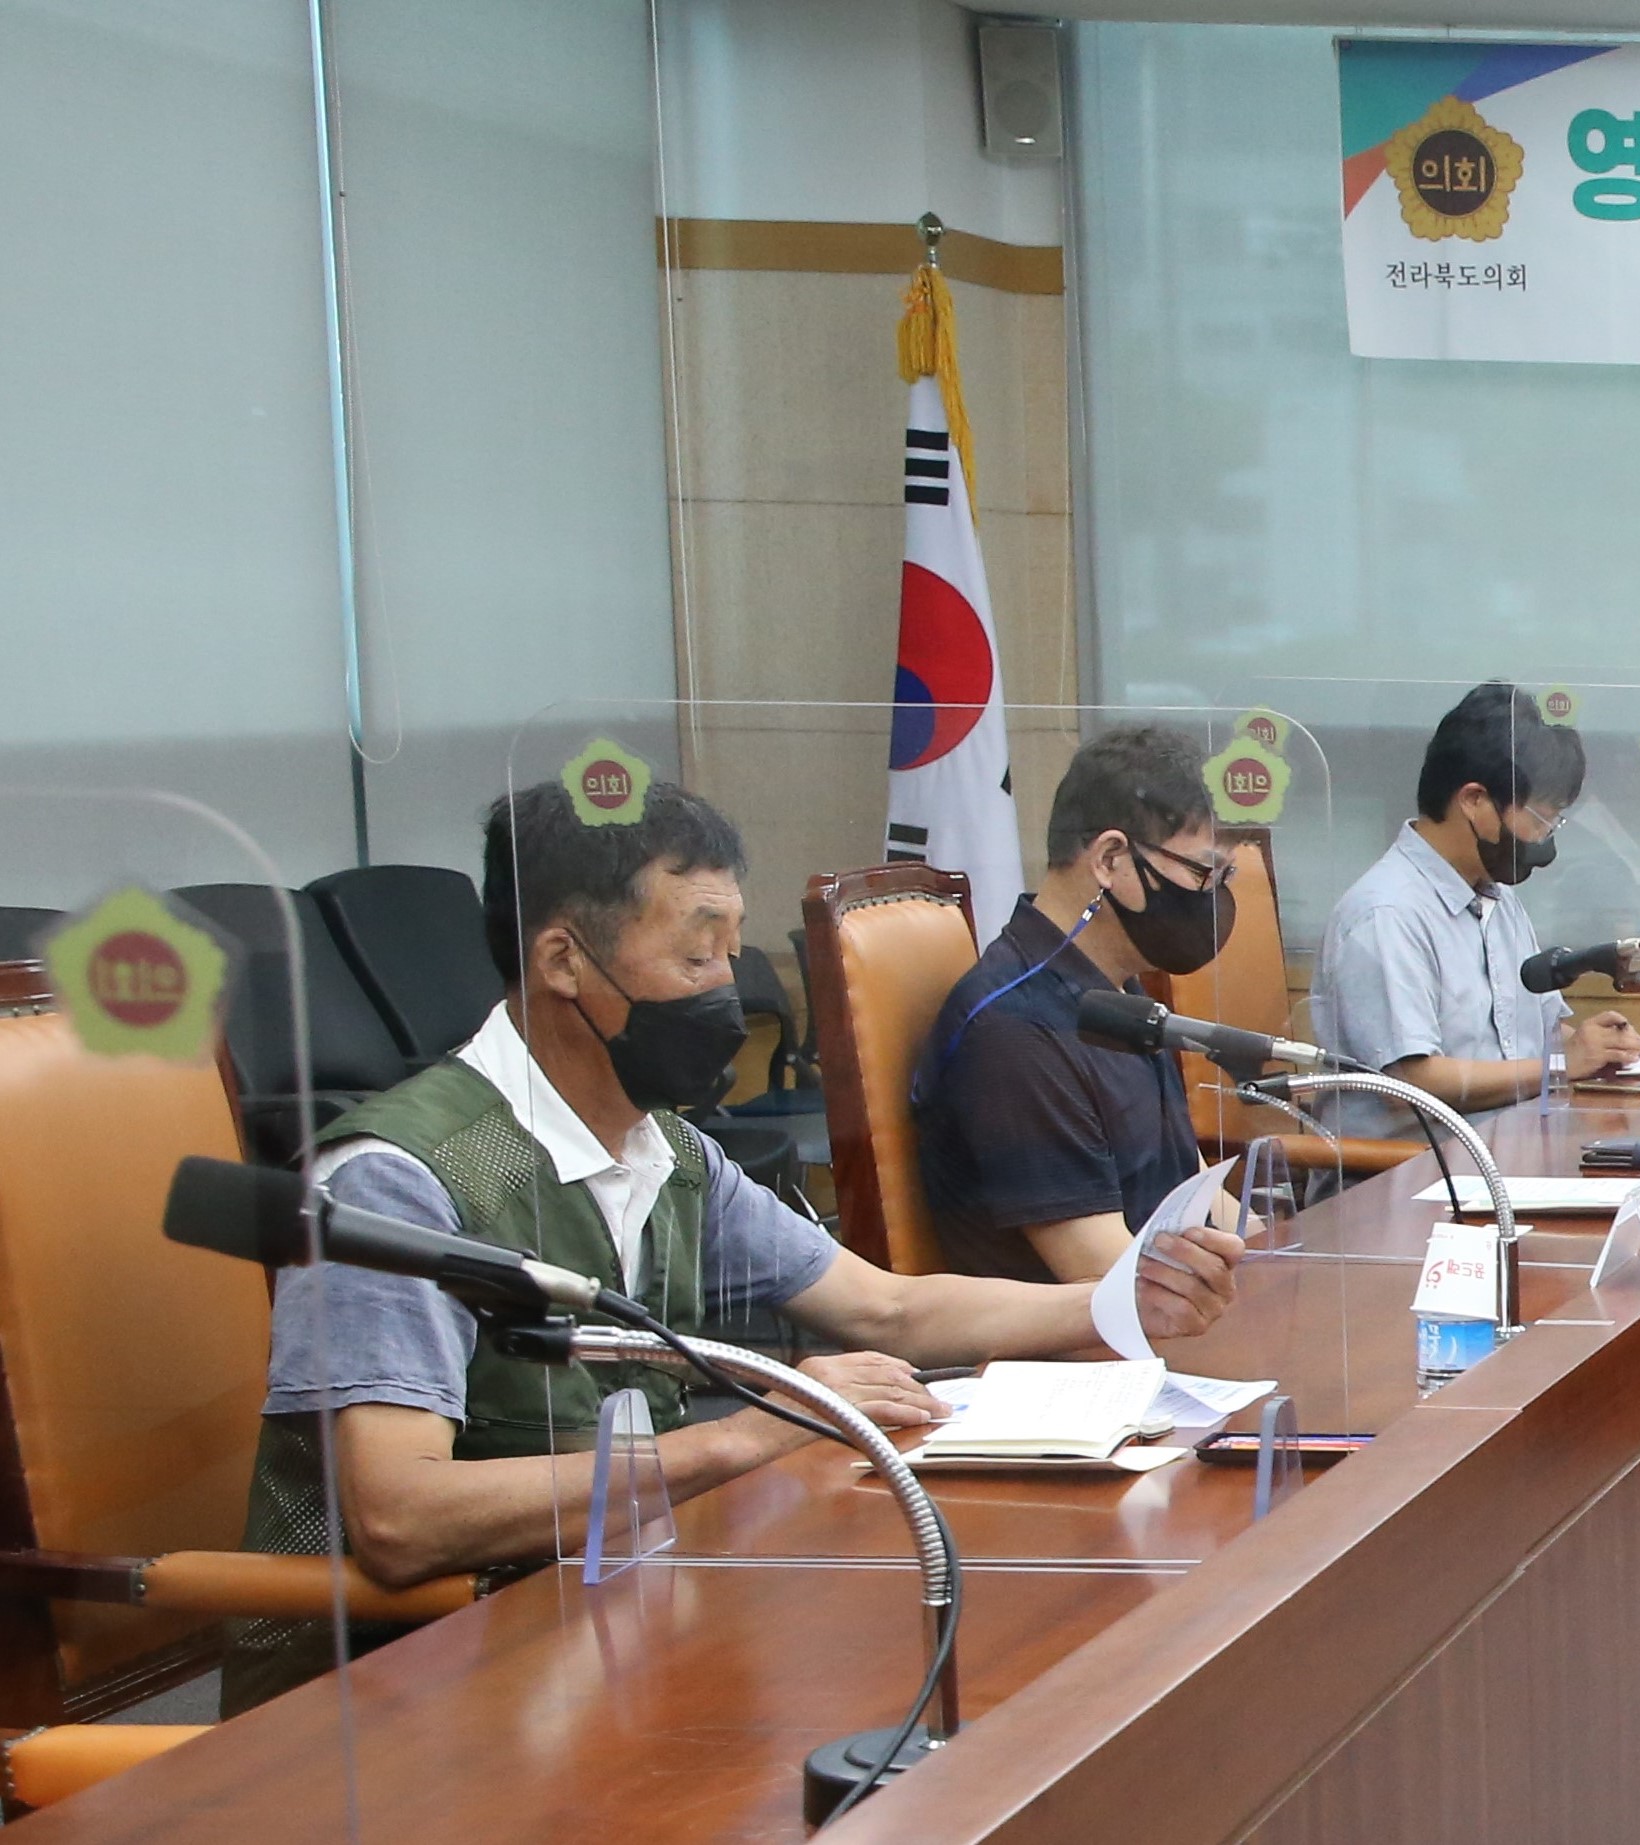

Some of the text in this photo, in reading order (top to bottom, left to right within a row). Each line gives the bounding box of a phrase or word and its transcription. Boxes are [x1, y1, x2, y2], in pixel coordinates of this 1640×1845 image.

[1418, 154, 1486, 193] 의회
[1385, 261, 1528, 292] 전라북도의회
[586, 772, 629, 797] 의회
